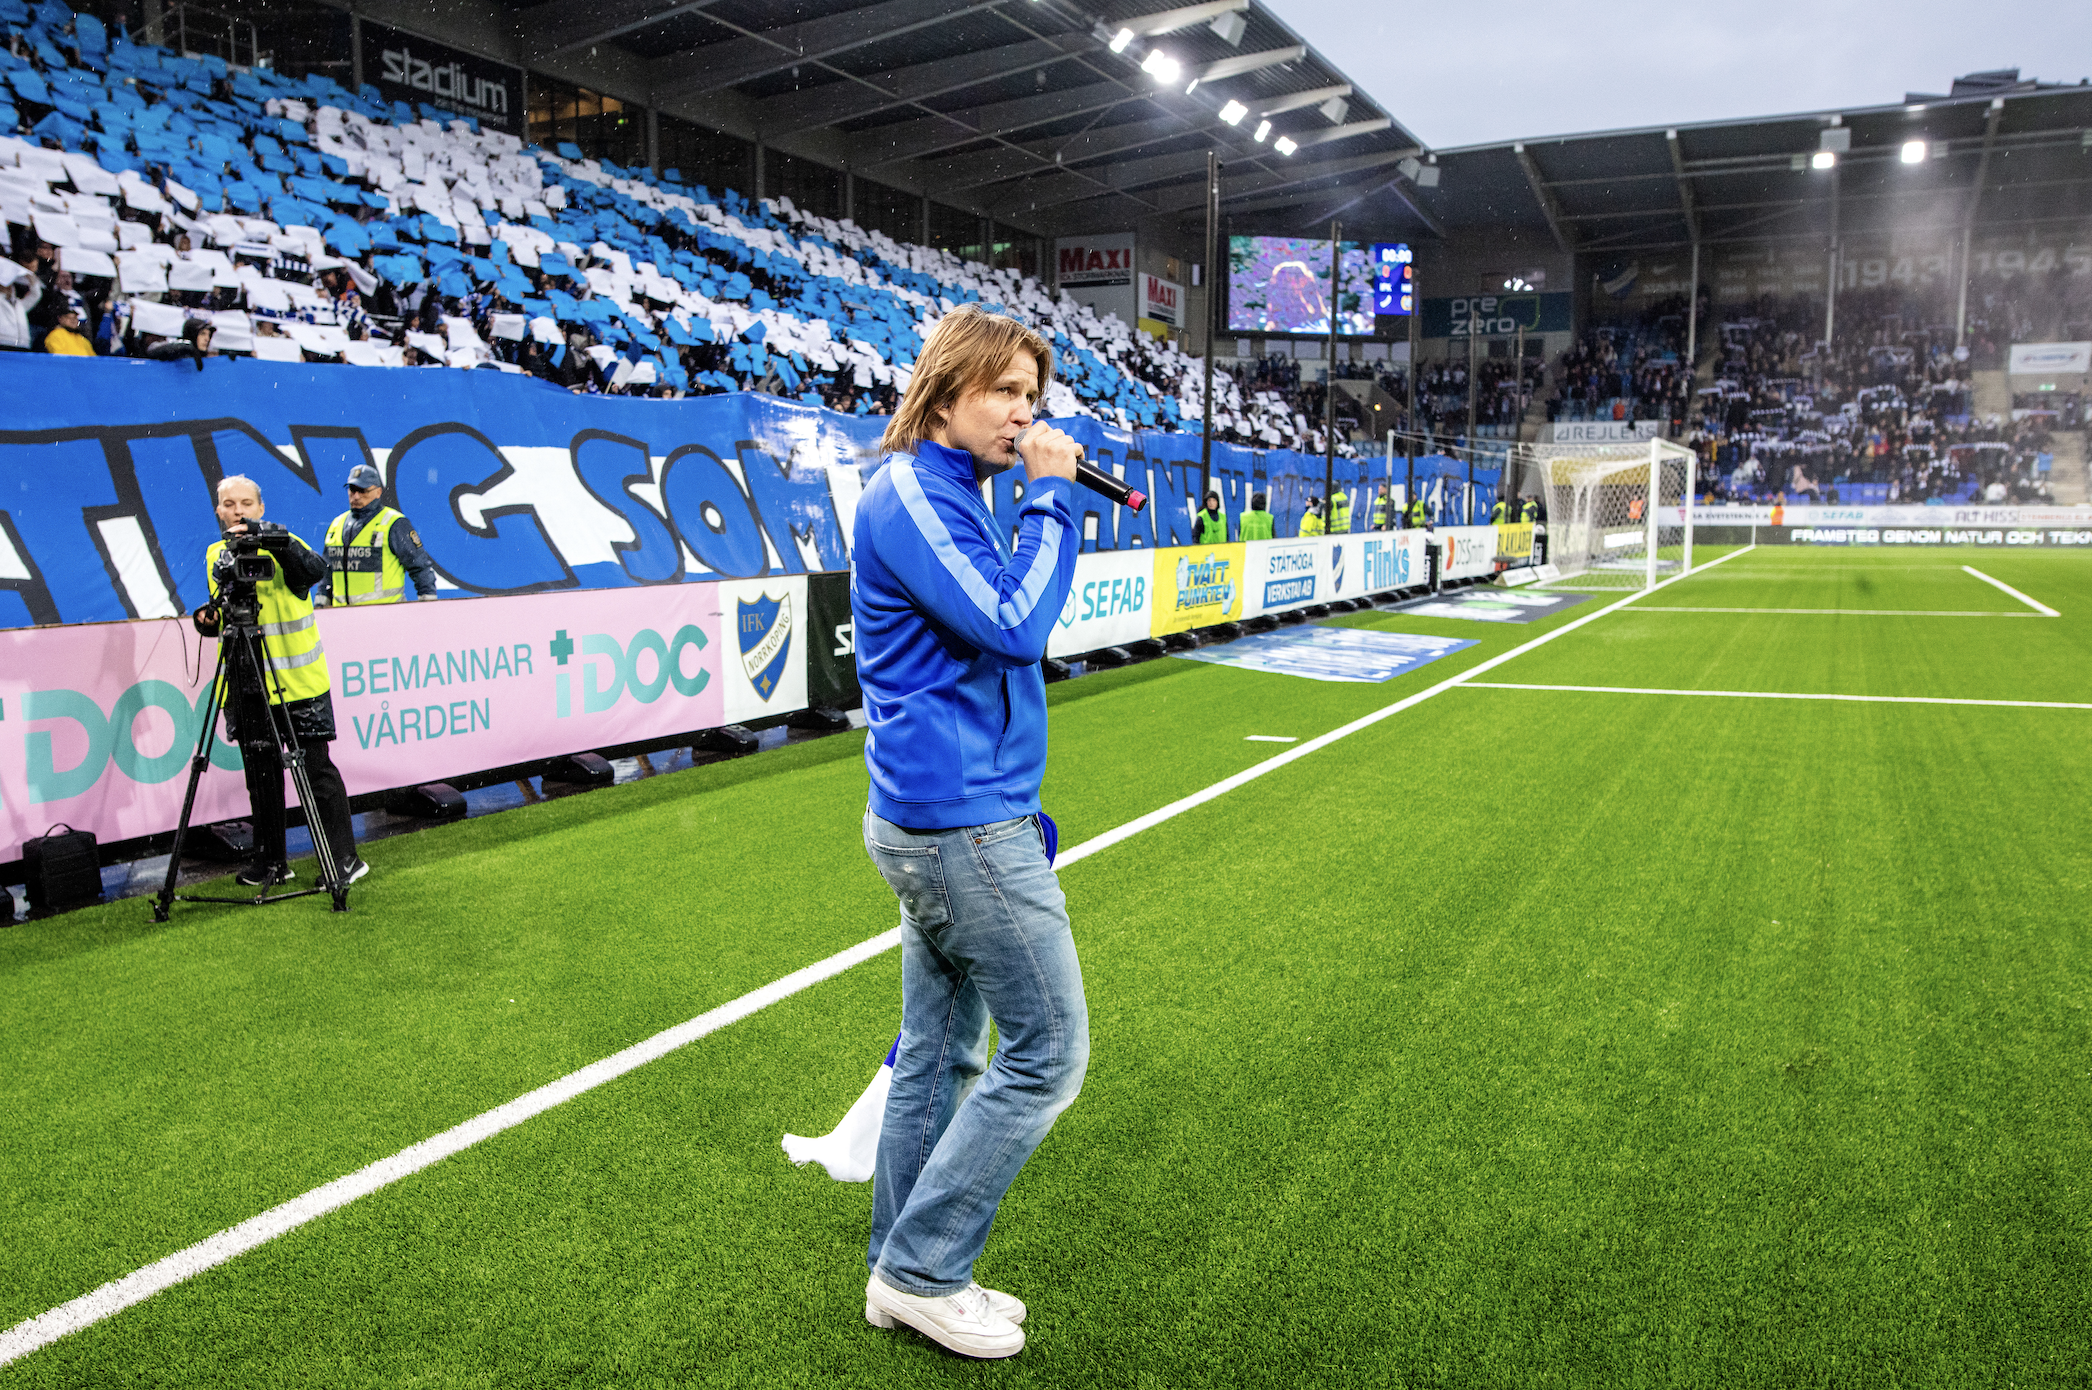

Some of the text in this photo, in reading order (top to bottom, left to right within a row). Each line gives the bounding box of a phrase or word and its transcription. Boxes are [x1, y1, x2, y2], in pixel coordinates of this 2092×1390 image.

[381, 47, 508, 113] stadium
[1060, 247, 1130, 273] MAXI
[1147, 275, 1176, 309] MAXI
[1452, 296, 1498, 318] pre
[1572, 425, 1656, 441] REJLERS
[570, 428, 850, 585] SOM
[1791, 528, 1879, 544] FRAMSTEG
[1882, 529, 1942, 544] GENOM
[1944, 530, 2003, 545] NATUR
[2005, 531, 2045, 545] OCH
[1364, 538, 1410, 591] Flinks
[1081, 576, 1145, 621] SEFAB
[742, 612, 766, 633] IFK
[748, 612, 790, 674] NORRKÖPING
[341, 643, 533, 698] BEMANNAR
[352, 697, 490, 750] VÅRDEN
